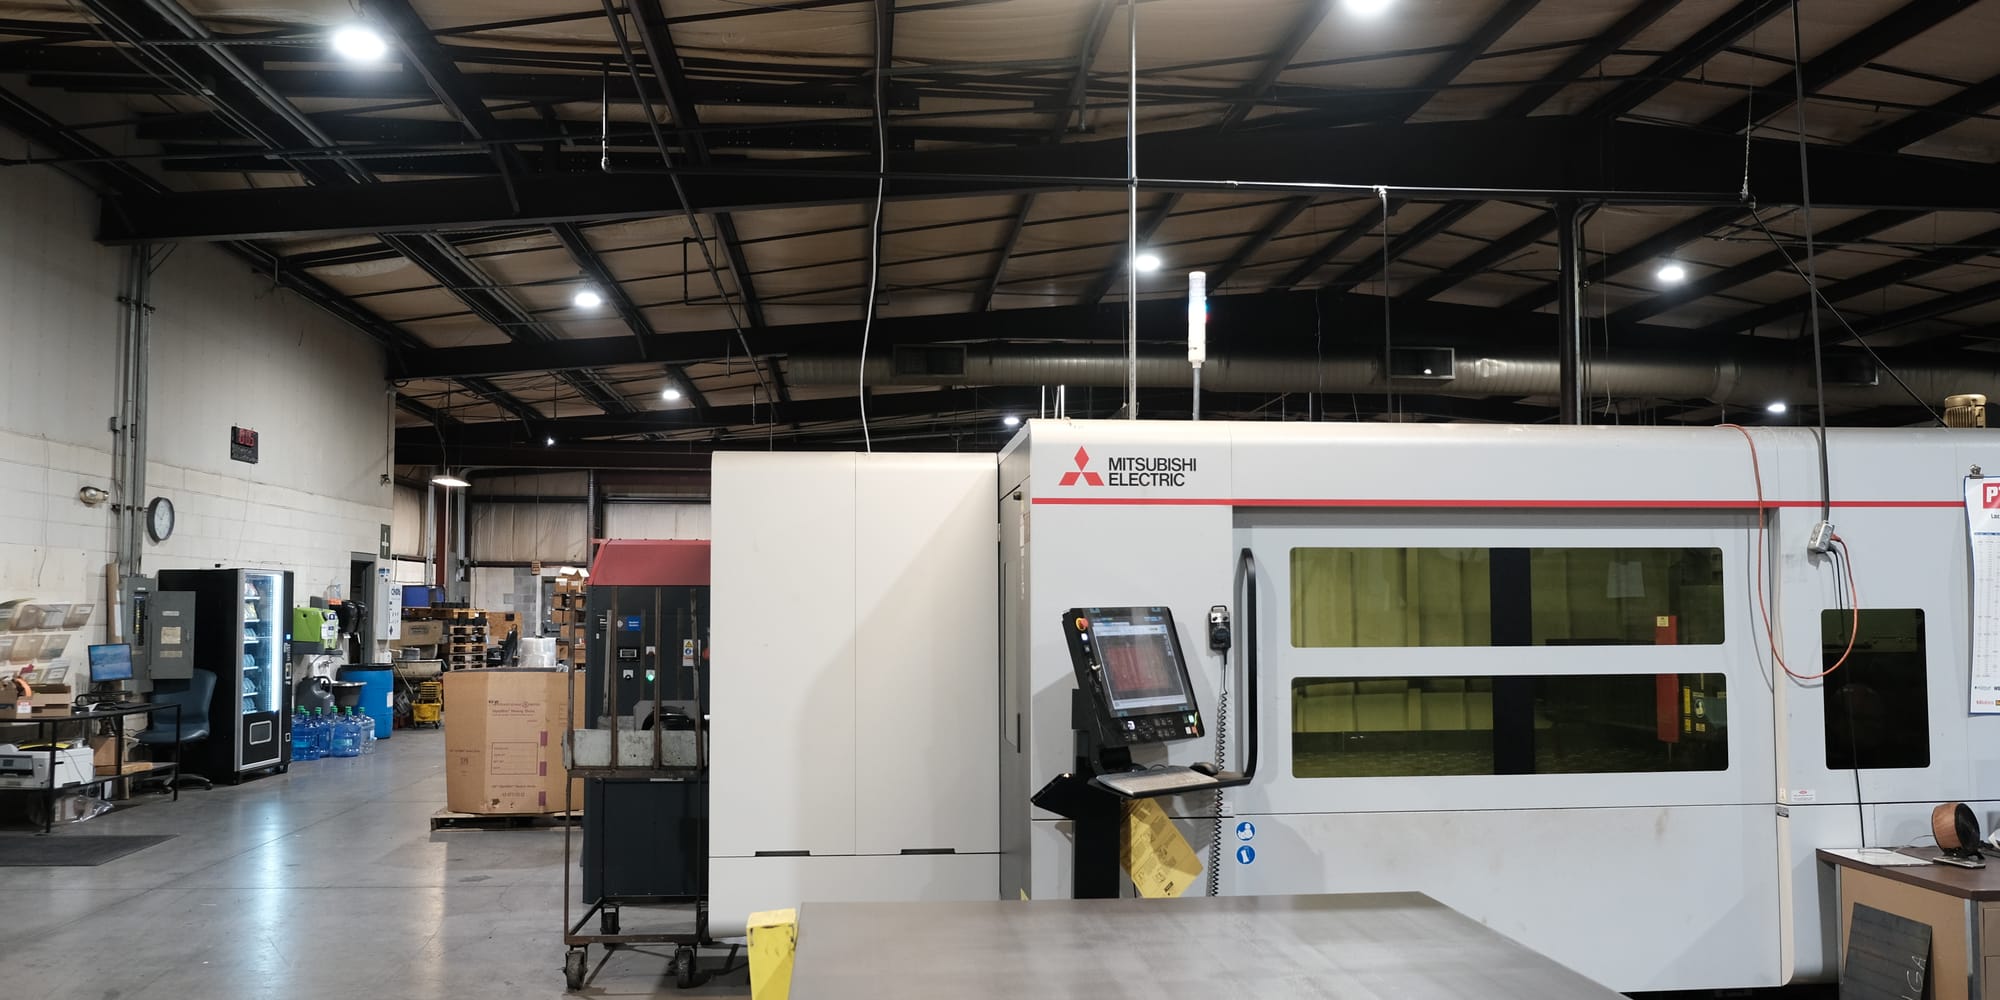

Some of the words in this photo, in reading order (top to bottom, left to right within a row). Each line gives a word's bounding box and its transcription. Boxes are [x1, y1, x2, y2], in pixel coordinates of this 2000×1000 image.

[1108, 457, 1197, 472] MITSUBISHI
[1108, 472, 1185, 487] ELECTRIC
[1986, 486, 2000, 503] P
